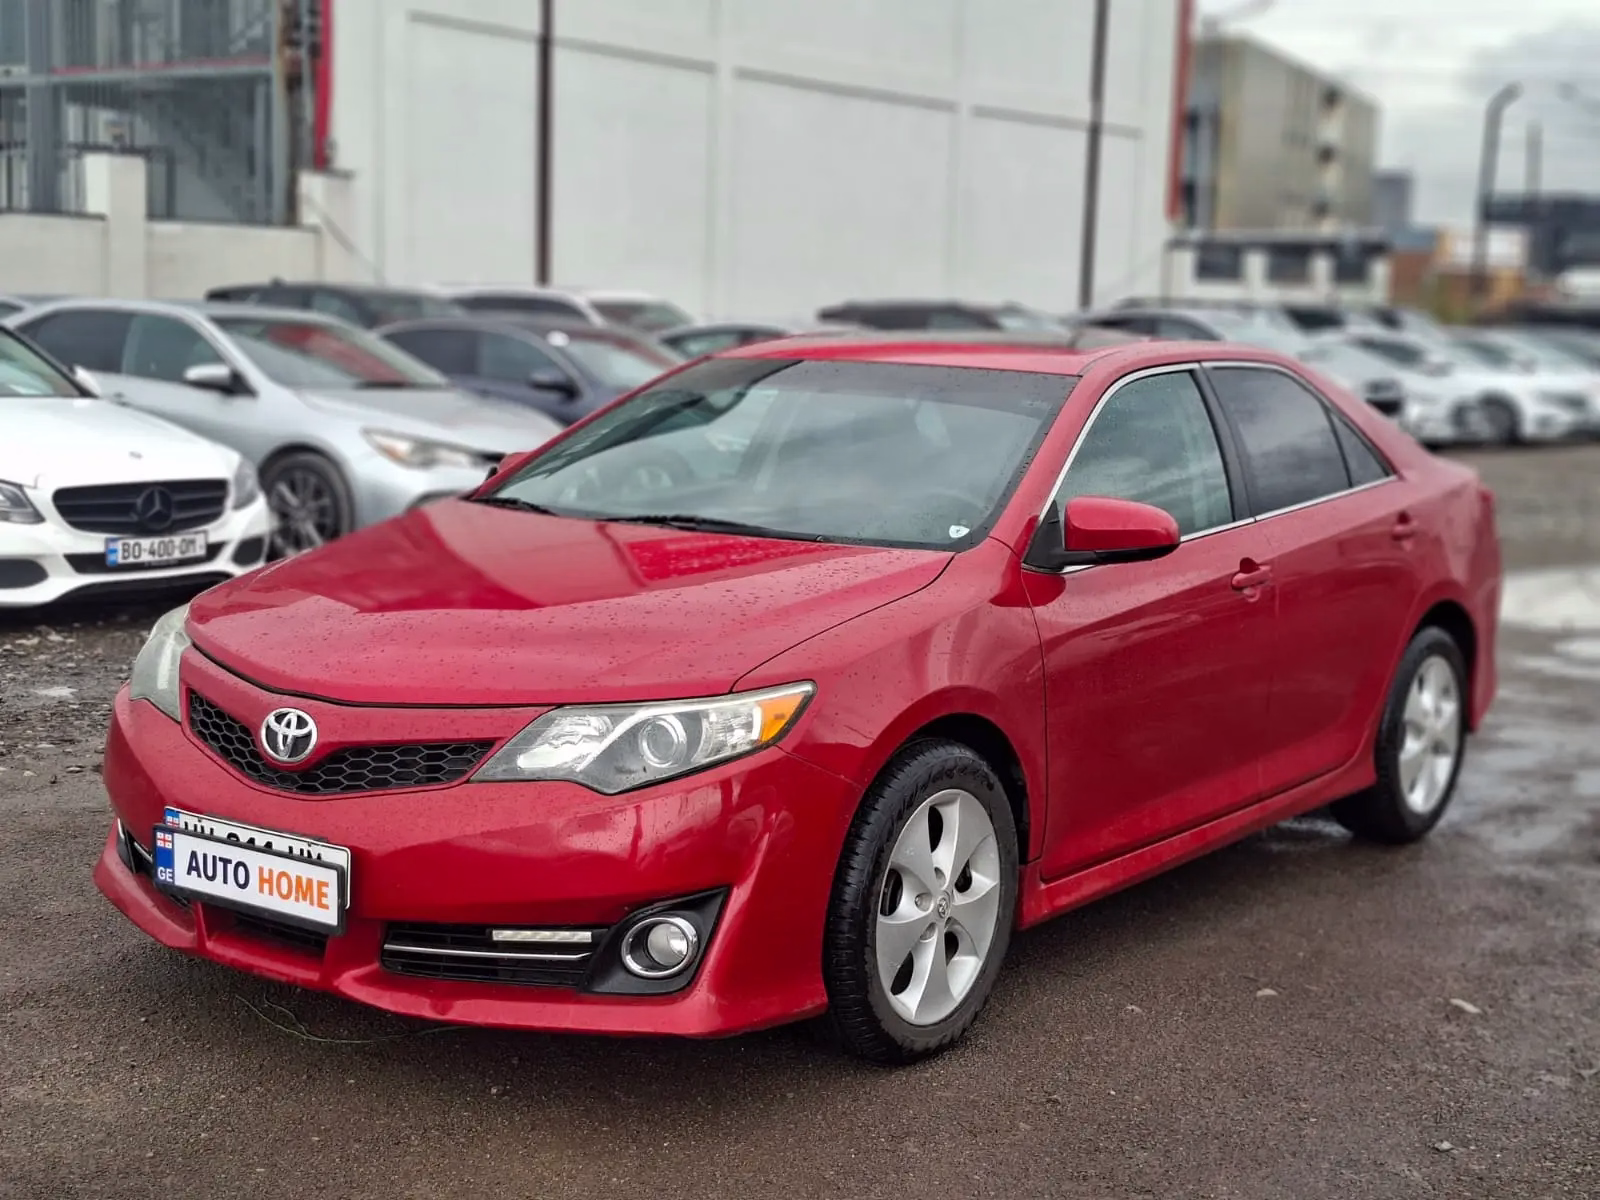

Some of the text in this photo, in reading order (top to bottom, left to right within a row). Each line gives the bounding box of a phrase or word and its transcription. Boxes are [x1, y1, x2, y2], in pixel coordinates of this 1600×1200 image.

[157, 866, 174, 882] GE
[186, 850, 330, 910] AUTO HOME
